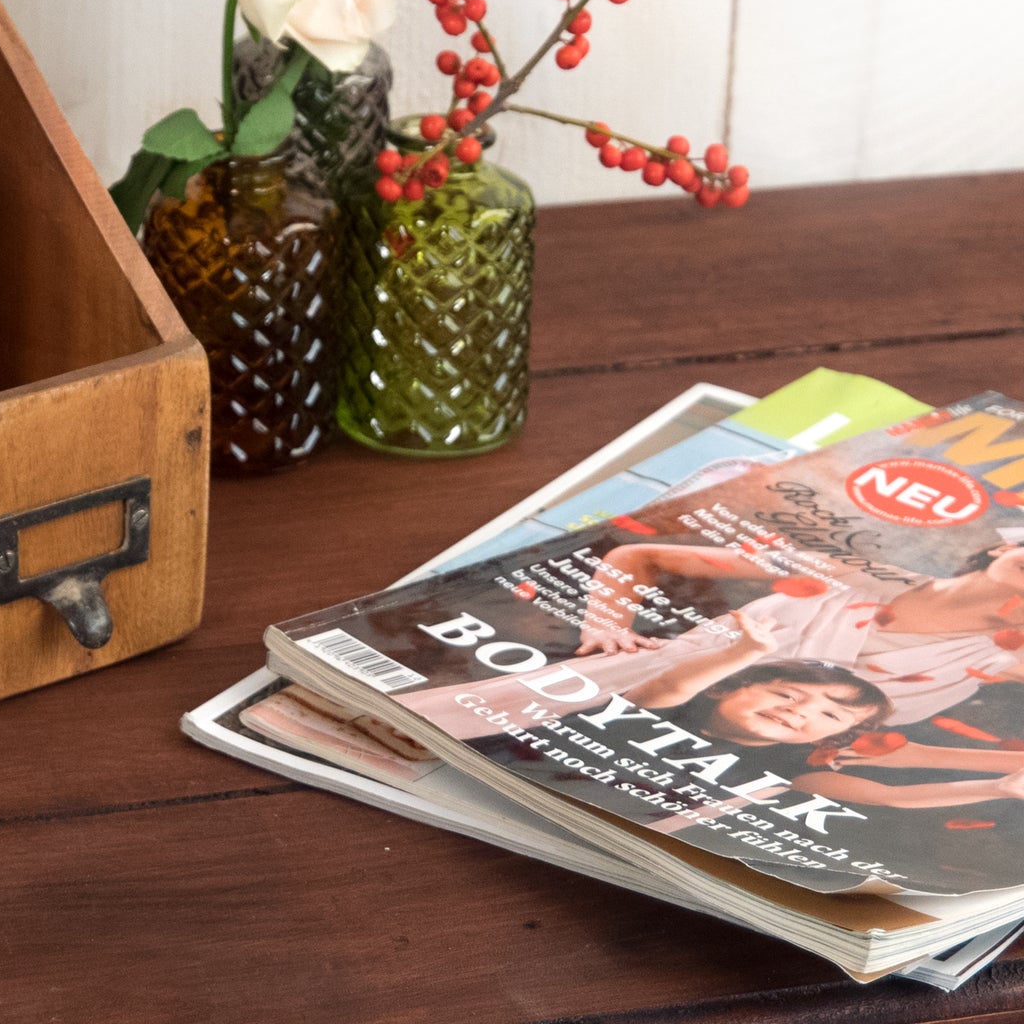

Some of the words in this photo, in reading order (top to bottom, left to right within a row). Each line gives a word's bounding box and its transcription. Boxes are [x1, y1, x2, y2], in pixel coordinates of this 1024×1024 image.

[766, 480, 864, 528] Rock
[853, 466, 980, 520] NEU
[678, 513, 703, 529] für
[700, 526, 726, 545] die
[725, 541, 791, 577] Festtage
[693, 508, 736, 536] Mode
[736, 532, 769, 552] und
[711, 502, 739, 522] Von
[739, 519, 777, 541] edel
[772, 533, 796, 555] bis
[754, 511, 917, 586] Glamour
[493, 575, 531, 599] neue
[511, 568, 577, 609] brauchen
[529, 563, 578, 596] Unsere
[578, 593, 624, 620] Söhne
[548, 557, 616, 597] Jungs
[615, 596, 679, 627] sein!
[572, 546, 634, 584] Lasst
[632, 583, 672, 609] die
[671, 606, 745, 641] Jungs
[417, 611, 869, 836] BODYTALK
[454, 692, 551, 751] Geburt
[543, 746, 618, 785] noch
[613, 781, 733, 832] schöner
[726, 829, 828, 871] fühlen
[520, 700, 616, 761] Warum
[613, 757, 676, 788] sich
[672, 782, 776, 832] Frauen
[773, 829, 851, 862] nach
[850, 860, 910, 882] der
